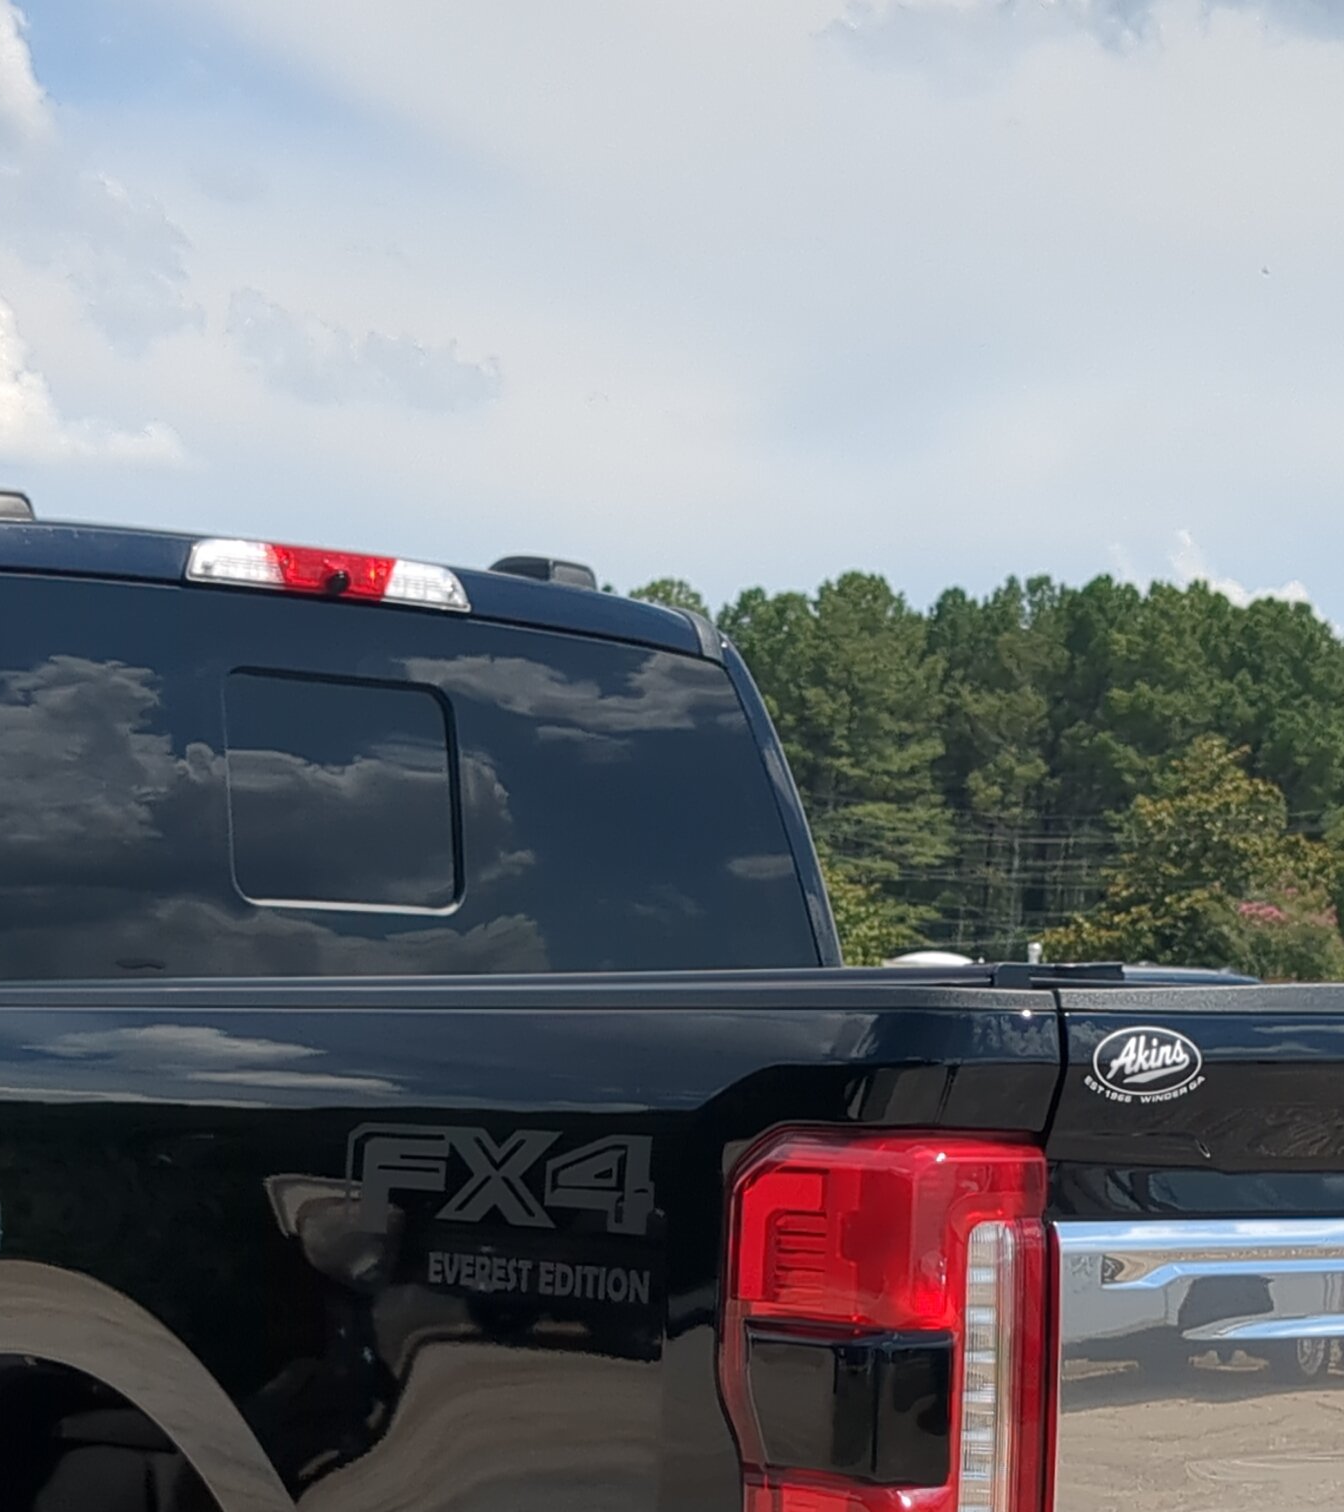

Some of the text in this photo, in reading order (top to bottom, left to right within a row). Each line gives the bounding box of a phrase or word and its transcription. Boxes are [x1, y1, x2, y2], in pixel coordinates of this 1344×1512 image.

[1106, 1035, 1190, 1080] Akins
[1140, 1086, 1187, 1104] WINDER
[1188, 1075, 1206, 1091] GA
[346, 1122, 655, 1235] FX4
[427, 1252, 651, 1304] EVEREST EDITION
